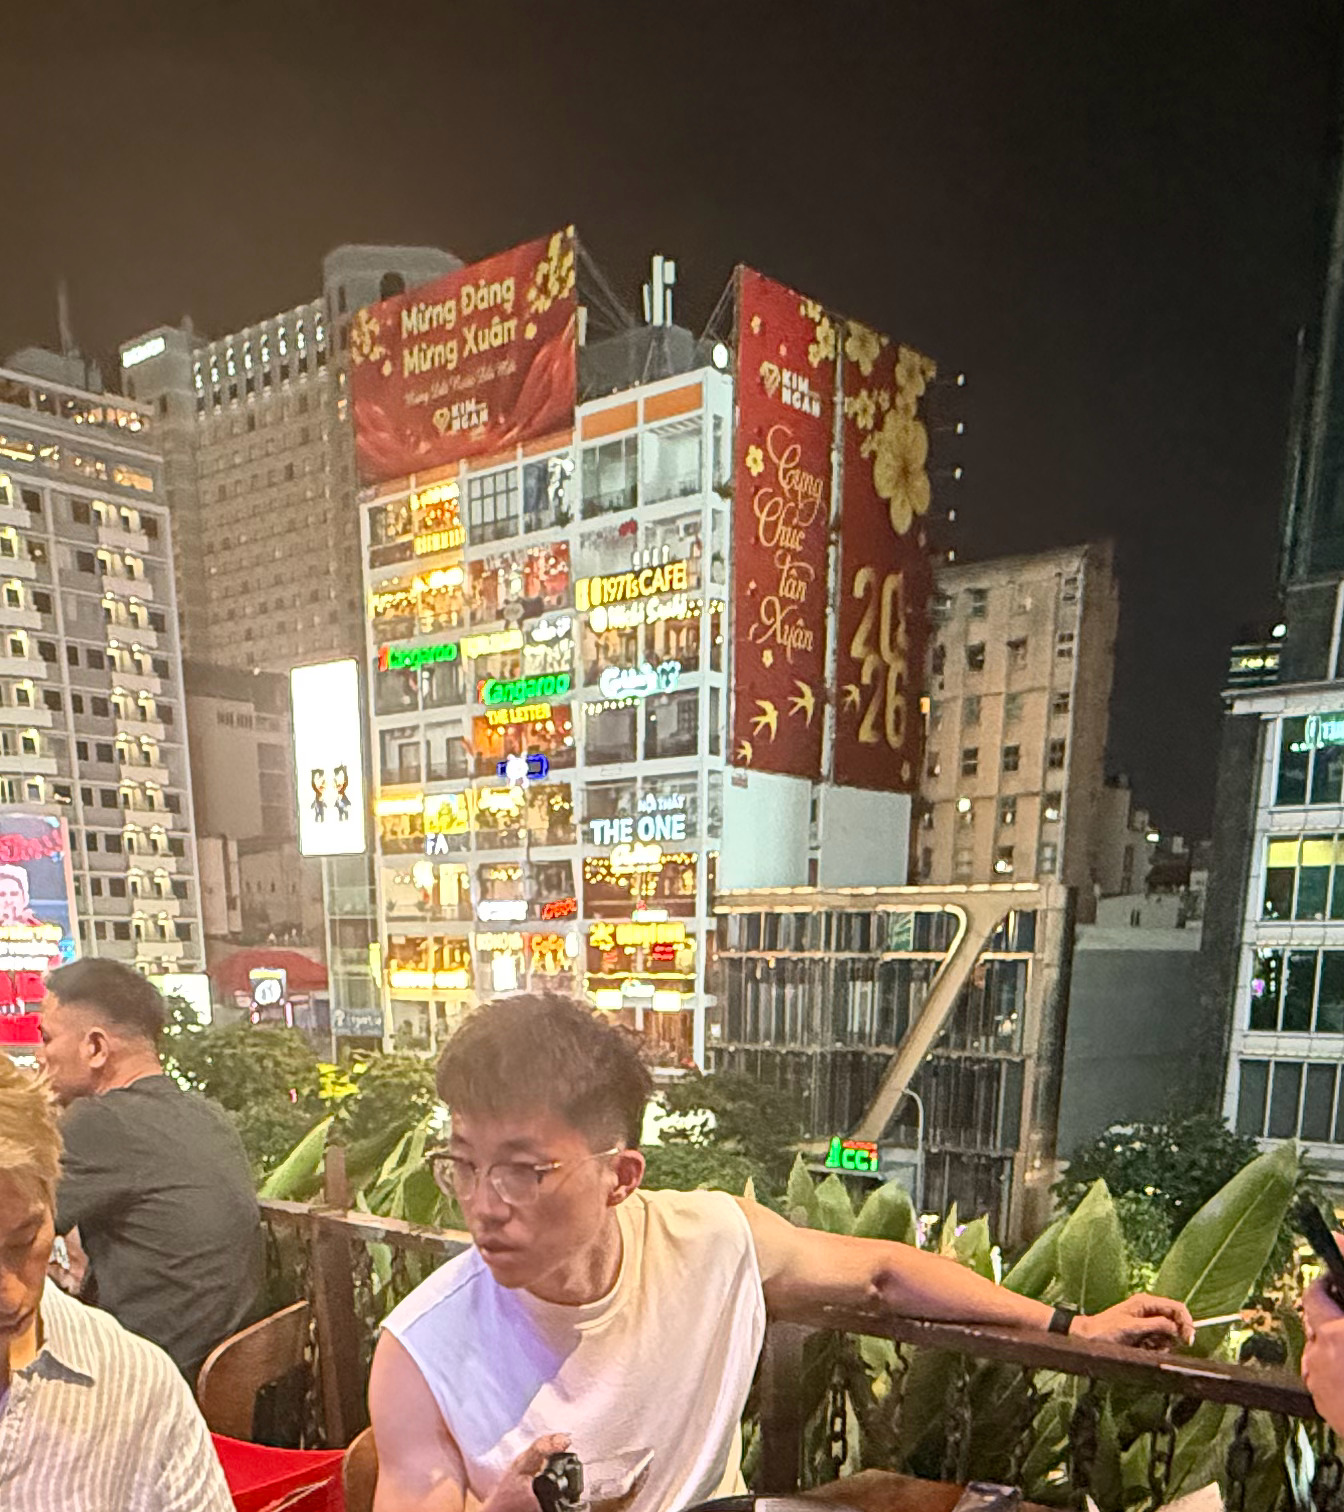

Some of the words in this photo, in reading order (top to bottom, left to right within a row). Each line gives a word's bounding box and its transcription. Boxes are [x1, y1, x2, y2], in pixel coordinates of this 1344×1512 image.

[401, 299, 456, 339] Mừng
[460, 277, 515, 316] Đảng
[403, 339, 457, 378] Mừng
[462, 316, 517, 357] Xuân
[782, 368, 809, 392] KIM
[590, 817, 634, 845] THE
[637, 813, 687, 841] ONE
